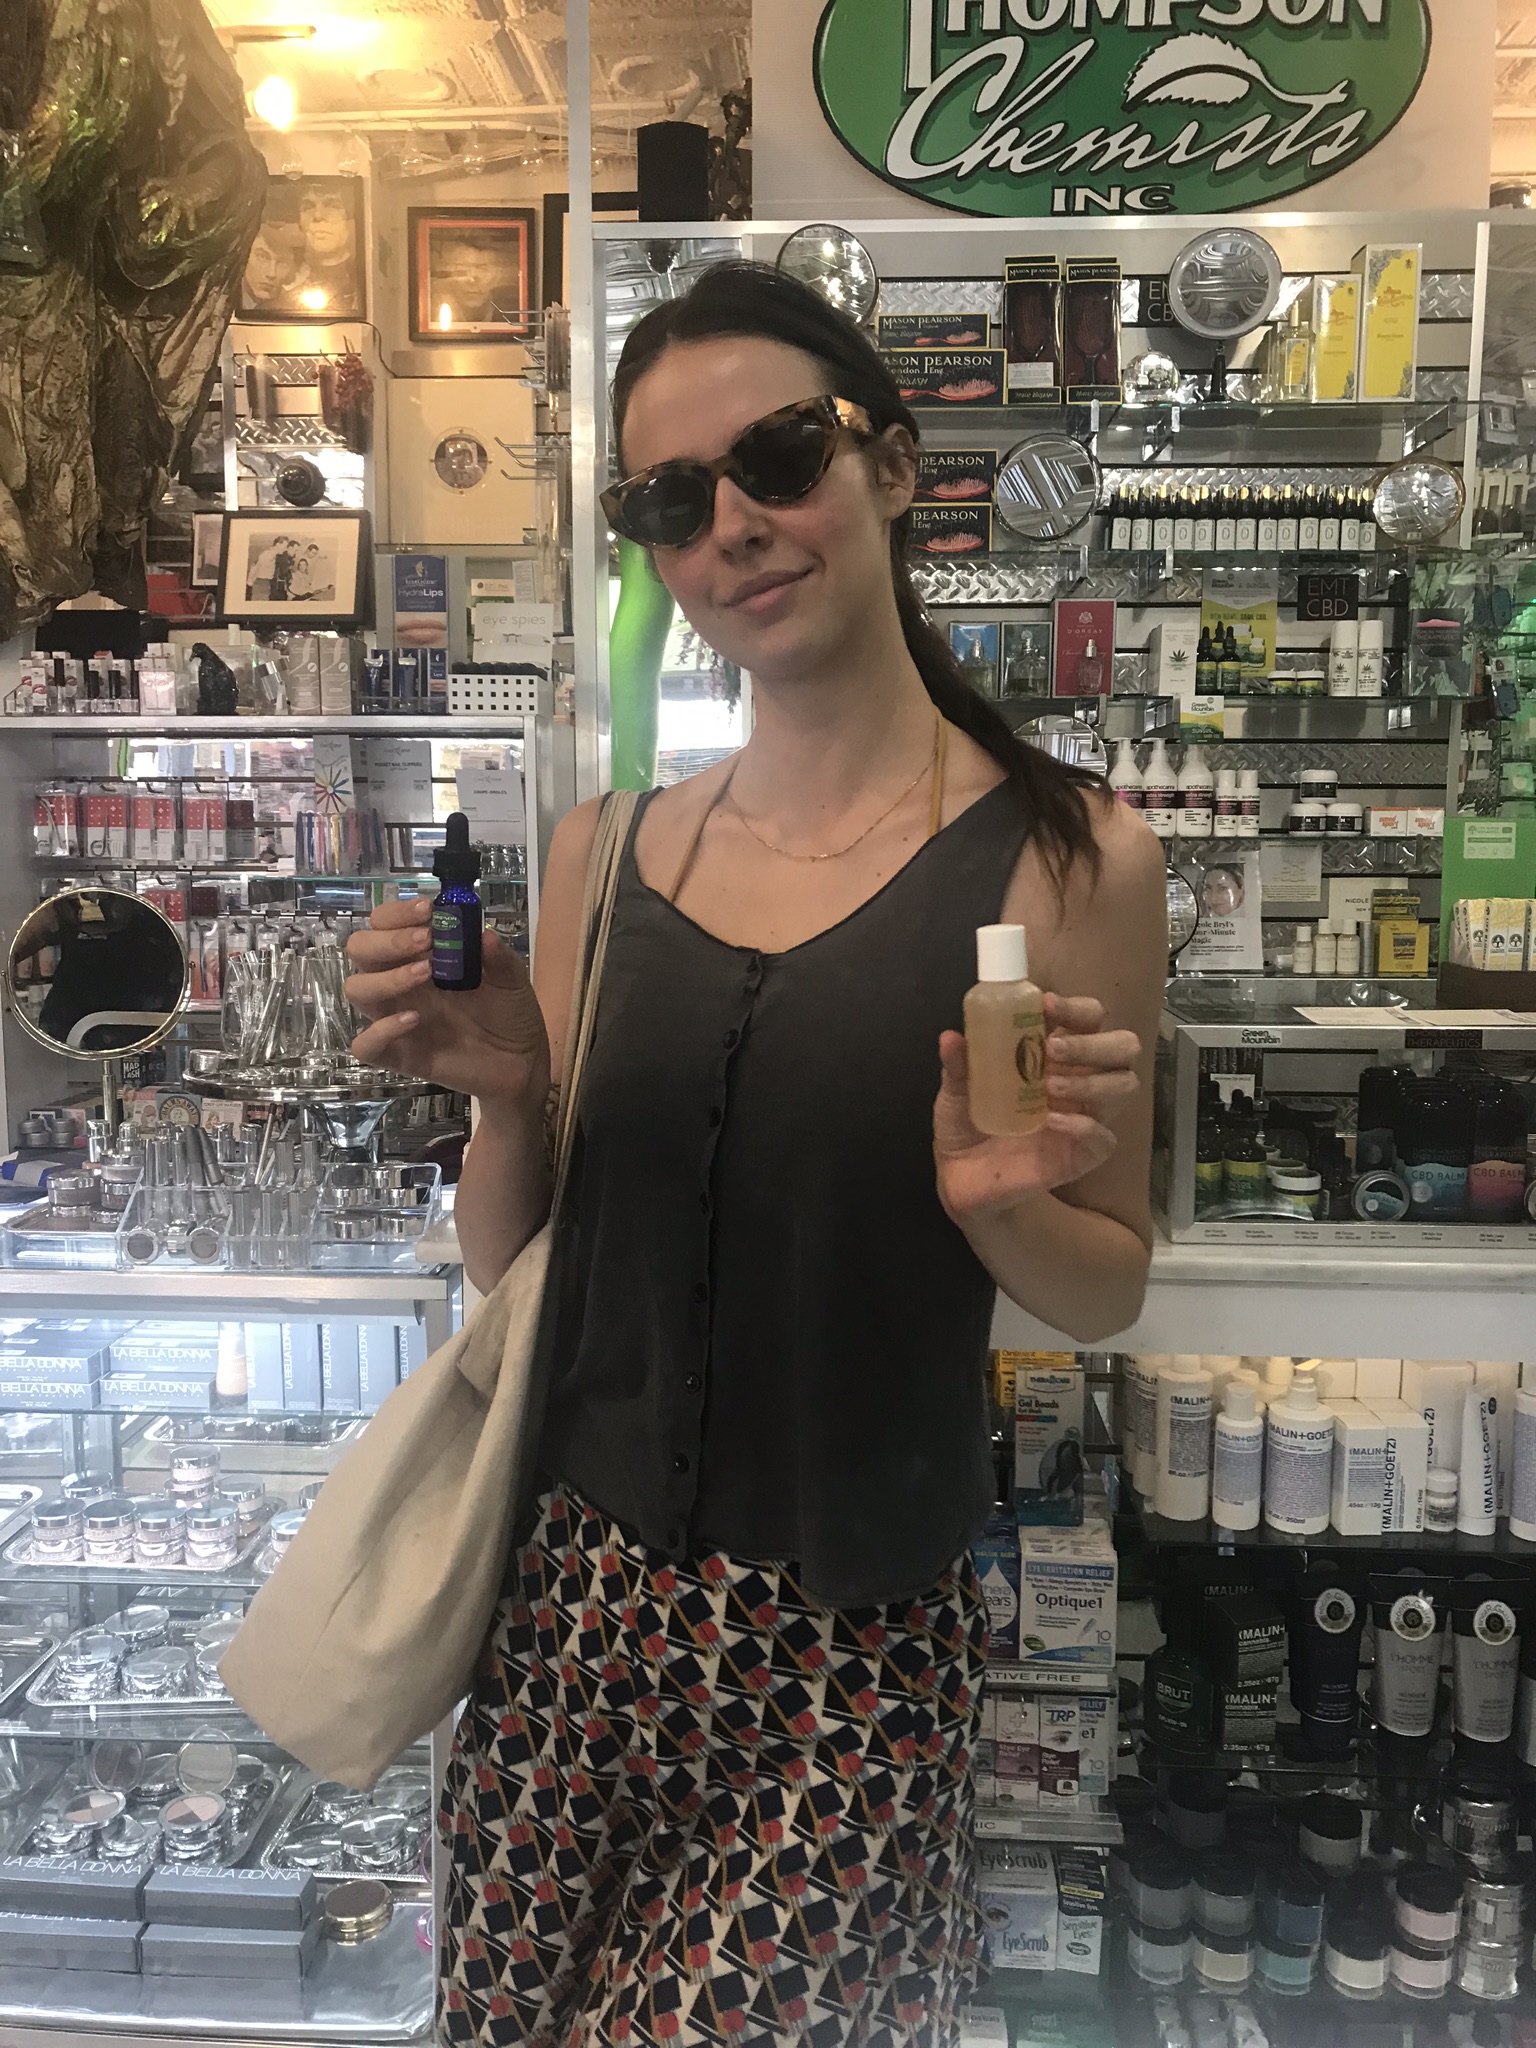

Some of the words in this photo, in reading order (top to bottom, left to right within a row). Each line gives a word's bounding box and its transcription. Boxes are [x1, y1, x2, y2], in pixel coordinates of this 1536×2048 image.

[885, 36, 1371, 180] Chemists
[1053, 184, 1175, 213] INC
[882, 317, 916, 329] MASON
[918, 316, 962, 329] PEARSON
[924, 355, 992, 373] PEARSON
[920, 455, 985, 472] PEARSON
[913, 510, 979, 528] PEARSON
[1308, 577, 1350, 596] EMT
[1306, 598, 1349, 617] CBD
[482, 615, 508, 628] eye
[511, 615, 546, 628] spies
[1241, 1035, 1281, 1044] Mountain
[1242, 1028, 1269, 1037] Green
[1407, 1038, 1480, 1048] THERAPEUTICS
[123, 1062, 139, 1073] MAD
[1411, 1170, 1434, 1180] CBD
[1437, 1172, 1464, 1181] BALM
[1473, 1168, 1496, 1178] CBD
[113, 1348, 128, 1357] LA
[129, 1348, 168, 1358] BELLA
[168, 1349, 212, 1359] DONNA
[37, 1359, 82, 1369] DONNA
[284, 1351, 292, 1378] BELLA
[323, 1351, 331, 1378] BELLA
[359, 1353, 368, 1381] BELLA
[1, 1383, 39, 1393] BELLA
[41, 1384, 86, 1394] DONNA
[104, 1381, 119, 1391] LA
[119, 1382, 157, 1392] BELLA
[159, 1382, 204, 1393] DONNA
[1018, 1400, 1032, 1408] Gel
[1035, 1400, 1059, 1409] Beads
[1480, 1401, 1494, 1514] (MALIN+GOETZ)
[1382, 1437, 1397, 1530] (MALIN+GOETZ)
[1027, 1565, 1041, 1573] EYE
[1043, 1565, 1084, 1575] IRRITATION
[1085, 1568, 1111, 1577] RELIEF
[983, 1595, 1011, 1607] ears
[1036, 1592, 1104, 1611] Optique1
[1096, 1630, 1112, 1645] 10
[1035, 1673, 1081, 1683] FREE
[1157, 1681, 1191, 1700] BRUT
[1046, 1709, 1076, 1722] TRP
[2, 1856, 22, 1867] LA
[23, 1858, 77, 1870] BELLA
[79, 1860, 142, 1875] DONNA
[981, 1852, 1047, 1870] EyeScrub
[159, 1865, 180, 1876] LA
[181, 1866, 236, 1879] BELLA
[237, 1868, 301, 1882] DONNA
[1002, 1932, 1049, 1953] EyeScrub
[1073, 1931, 1091, 1940] Eyes
